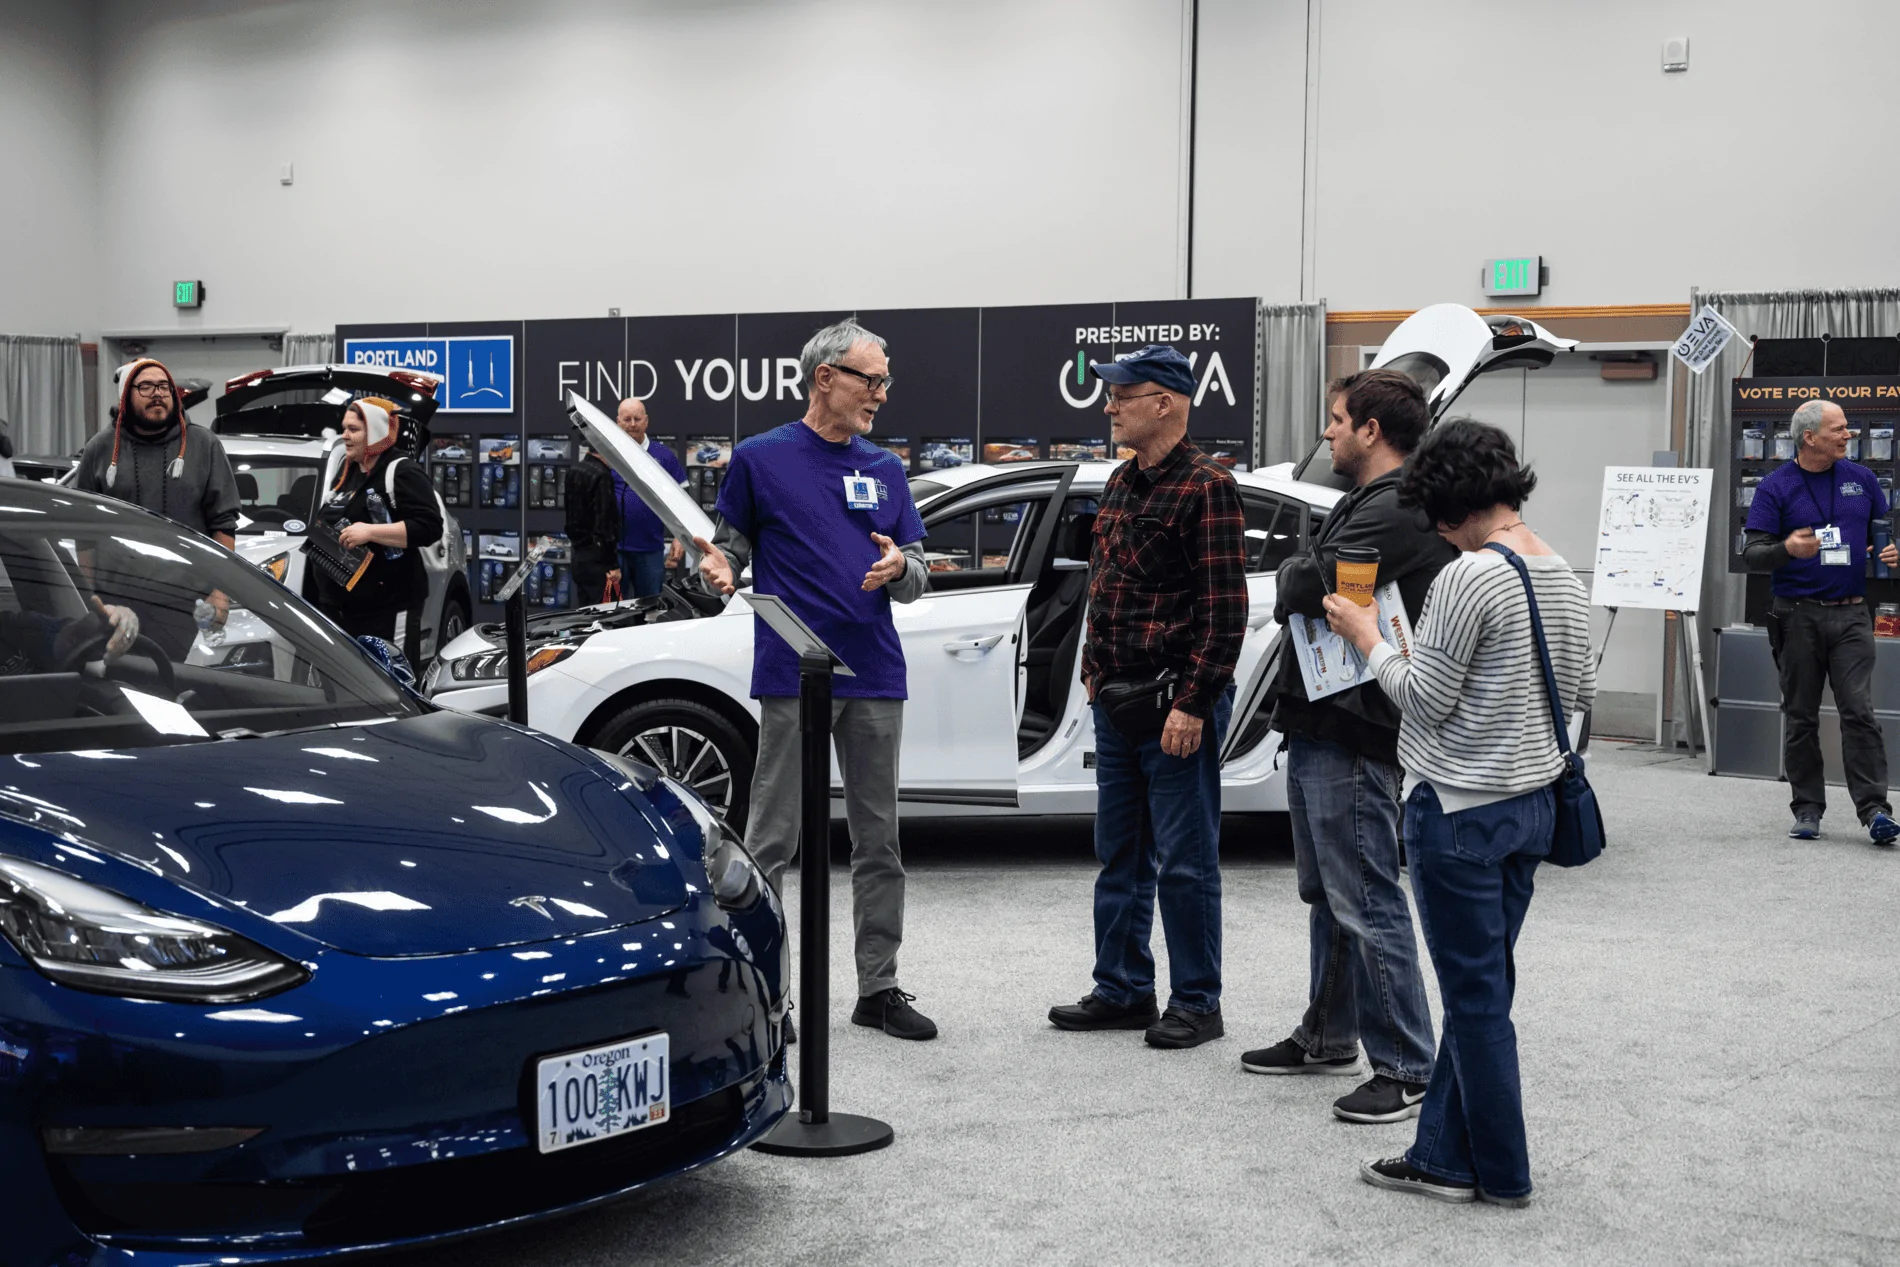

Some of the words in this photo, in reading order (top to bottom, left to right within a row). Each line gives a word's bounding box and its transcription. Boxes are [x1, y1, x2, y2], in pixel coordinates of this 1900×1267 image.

[1493, 259, 1531, 290] EXIT
[1075, 326, 1183, 344] PRESENTED
[1189, 324, 1220, 341] BY:
[354, 349, 438, 367] PORTLAND
[558, 360, 658, 401] FIND
[674, 358, 804, 401] YOUR
[1738, 387, 1783, 399] VOTE
[1787, 387, 1821, 399] FOR
[1825, 386, 1872, 398] YOUR
[1616, 473, 1634, 483] SEE
[1636, 474, 1654, 483] ALL
[1656, 474, 1676, 484] THE
[1391, 615, 1411, 658] WESTON
[582, 1048, 631, 1068] Oregon
[548, 1073, 598, 1128] 100
[617, 1056, 664, 1112] KWJ
[550, 1132, 557, 1145] 7
